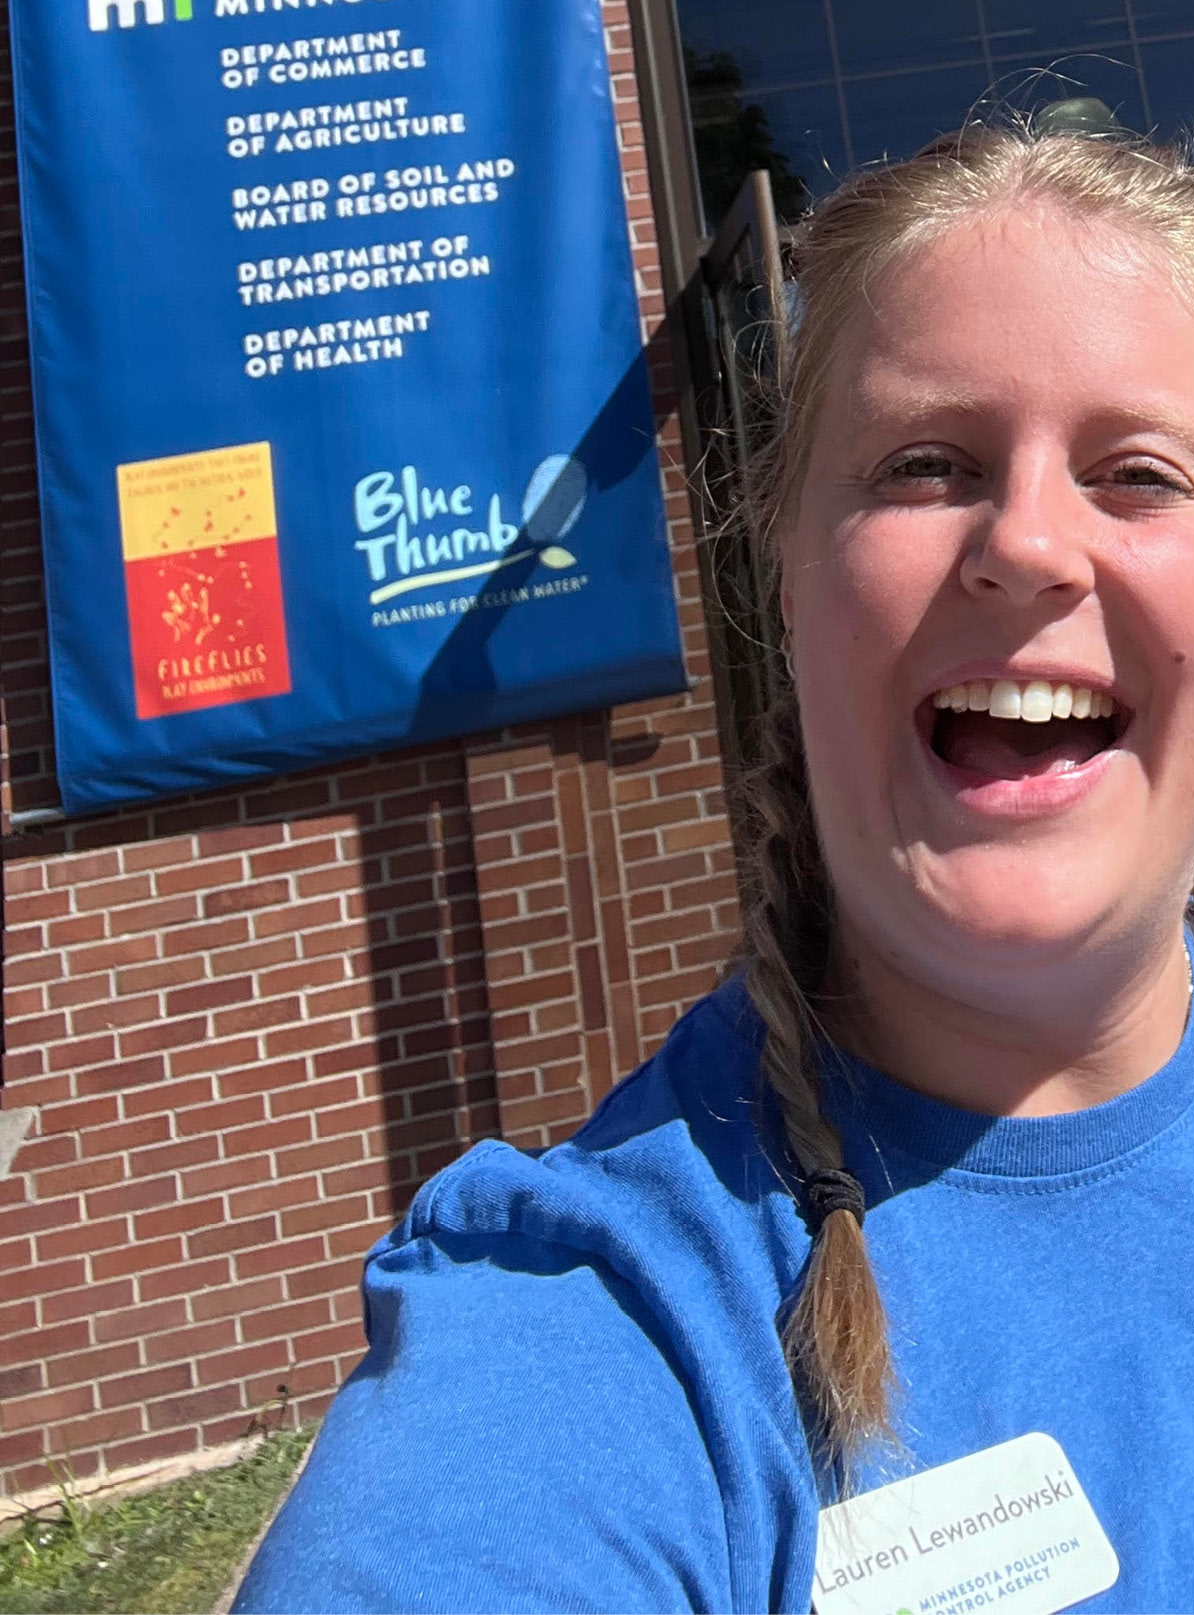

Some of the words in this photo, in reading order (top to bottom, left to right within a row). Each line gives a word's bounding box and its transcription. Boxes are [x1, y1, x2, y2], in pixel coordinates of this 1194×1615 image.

[221, 29, 401, 68] DEPARTMENT
[222, 67, 260, 88] OF
[269, 48, 426, 83] COMMERCE
[226, 97, 408, 136] DEPARTMENT
[227, 135, 265, 158] OF
[275, 113, 466, 152] AGRICULTURE
[232, 178, 329, 209] BOARD
[338, 172, 376, 194] OF
[384, 164, 449, 190] SOIL
[457, 158, 515, 182] AND
[233, 200, 326, 231] WATER
[336, 182, 498, 218] RESOURCES
[237, 240, 423, 283] DEPARTMENT
[431, 235, 469, 257] OF
[239, 255, 490, 306] TRANSPORTATION
[244, 310, 430, 355] DEPARTMENT
[245, 354, 283, 378] OF
[294, 337, 403, 371] HEALTH
[355, 465, 473, 533] Blue
[354, 492, 519, 581] Thumb
[371, 600, 447, 627] PLANTING
[450, 595, 480, 613] FOR
[483, 587, 530, 607] CLEAN
[815, 1542, 909, 1595] Lauren
[908, 1469, 1075, 1555] Lewandowski
[919, 1570, 1003, 1612] MINNESOTA
[1004, 1537, 1081, 1577] POLLUTION
[922, 1591, 994, 1615] ONTROL
[998, 1566, 1051, 1599] AGENCY
